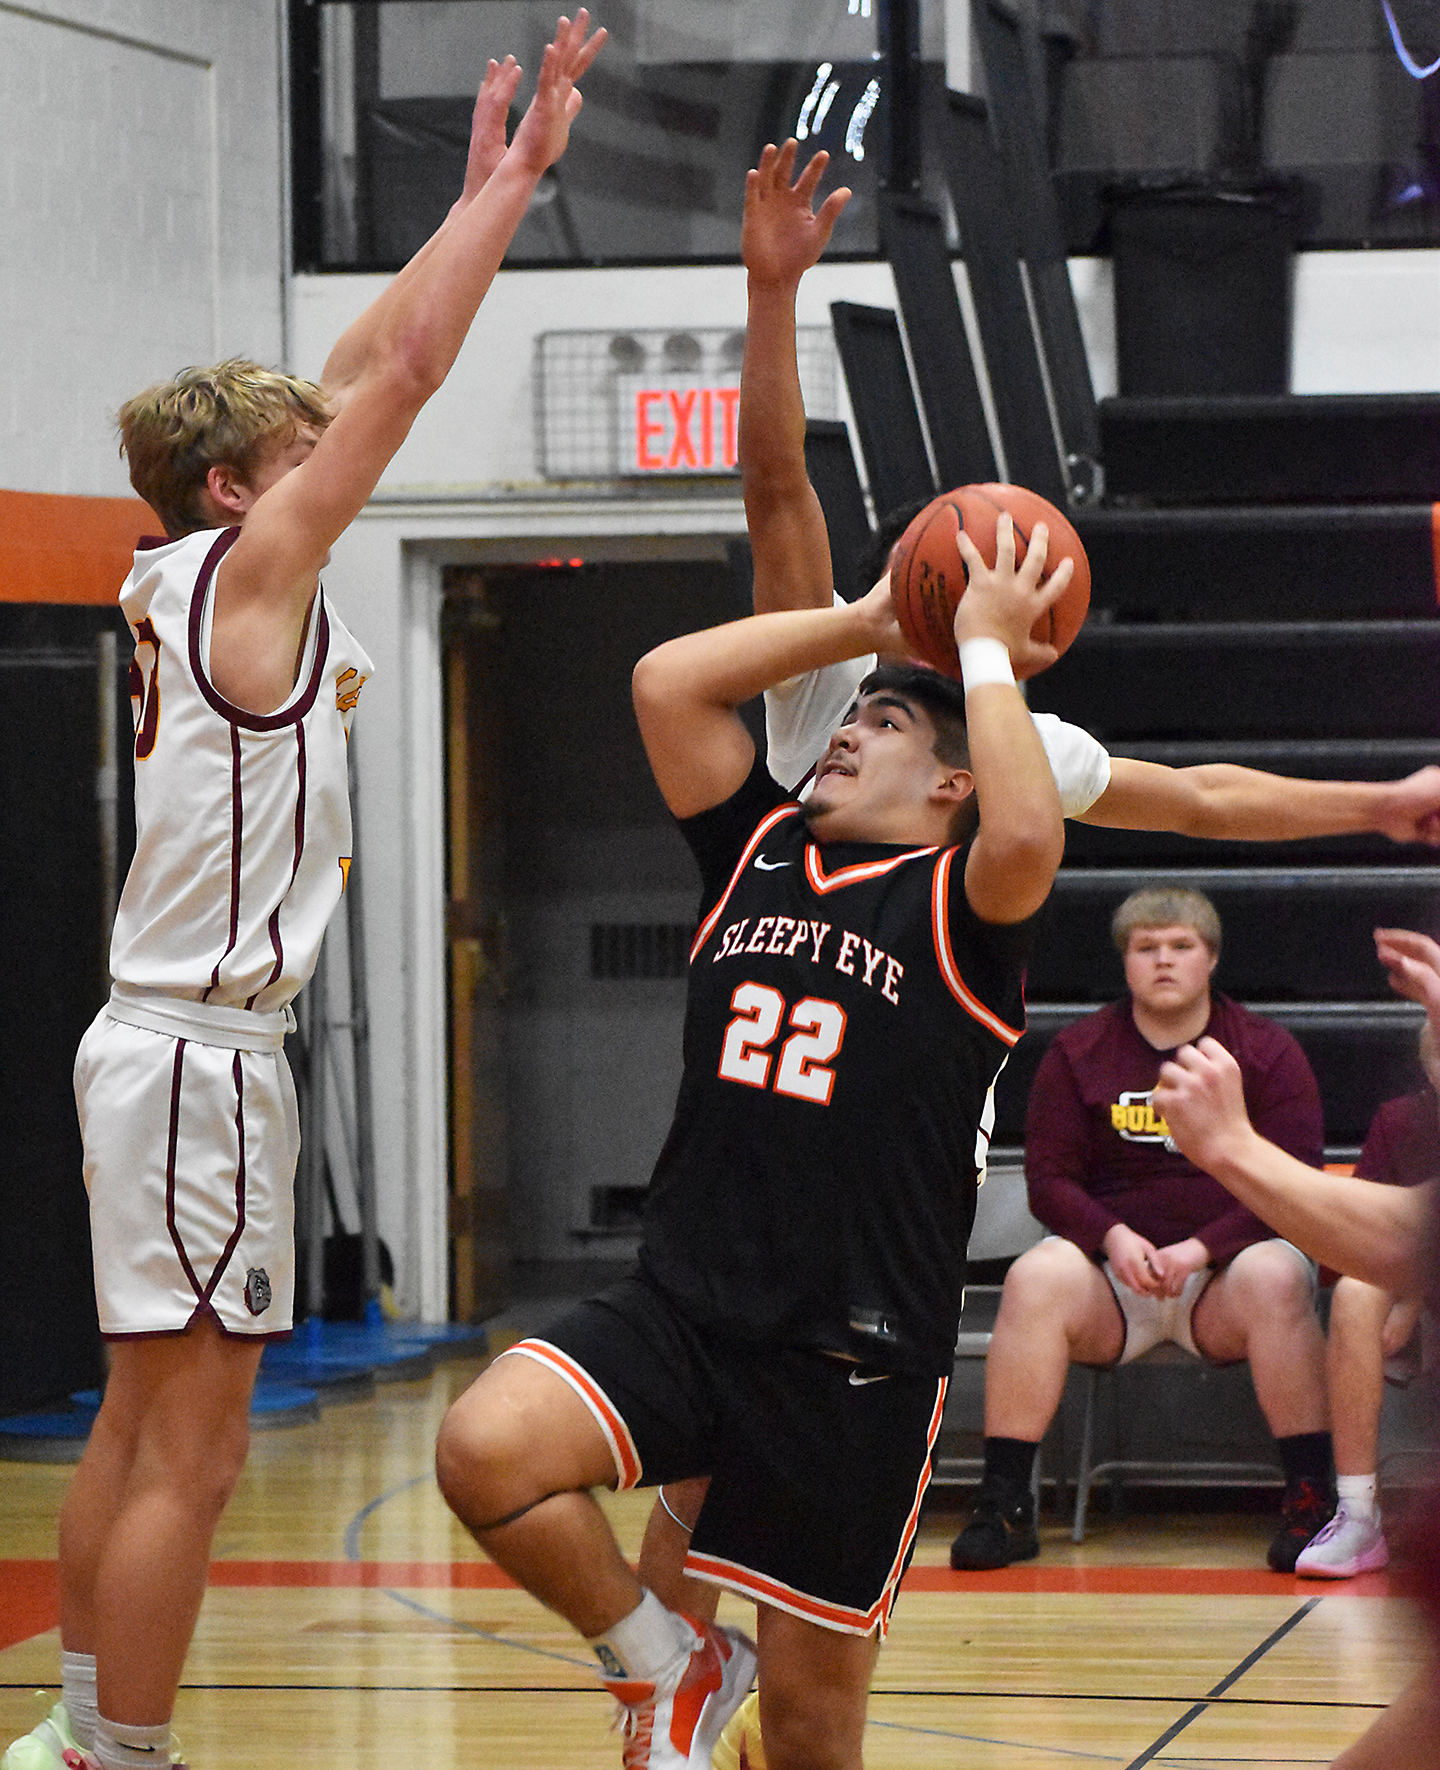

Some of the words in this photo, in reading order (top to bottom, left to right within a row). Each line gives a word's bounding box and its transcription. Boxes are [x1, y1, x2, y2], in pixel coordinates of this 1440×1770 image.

[635, 387, 741, 470] EXIT
[713, 915, 832, 963] SLEEPY
[835, 930, 905, 1006] EYE
[717, 980, 848, 1107] 22
